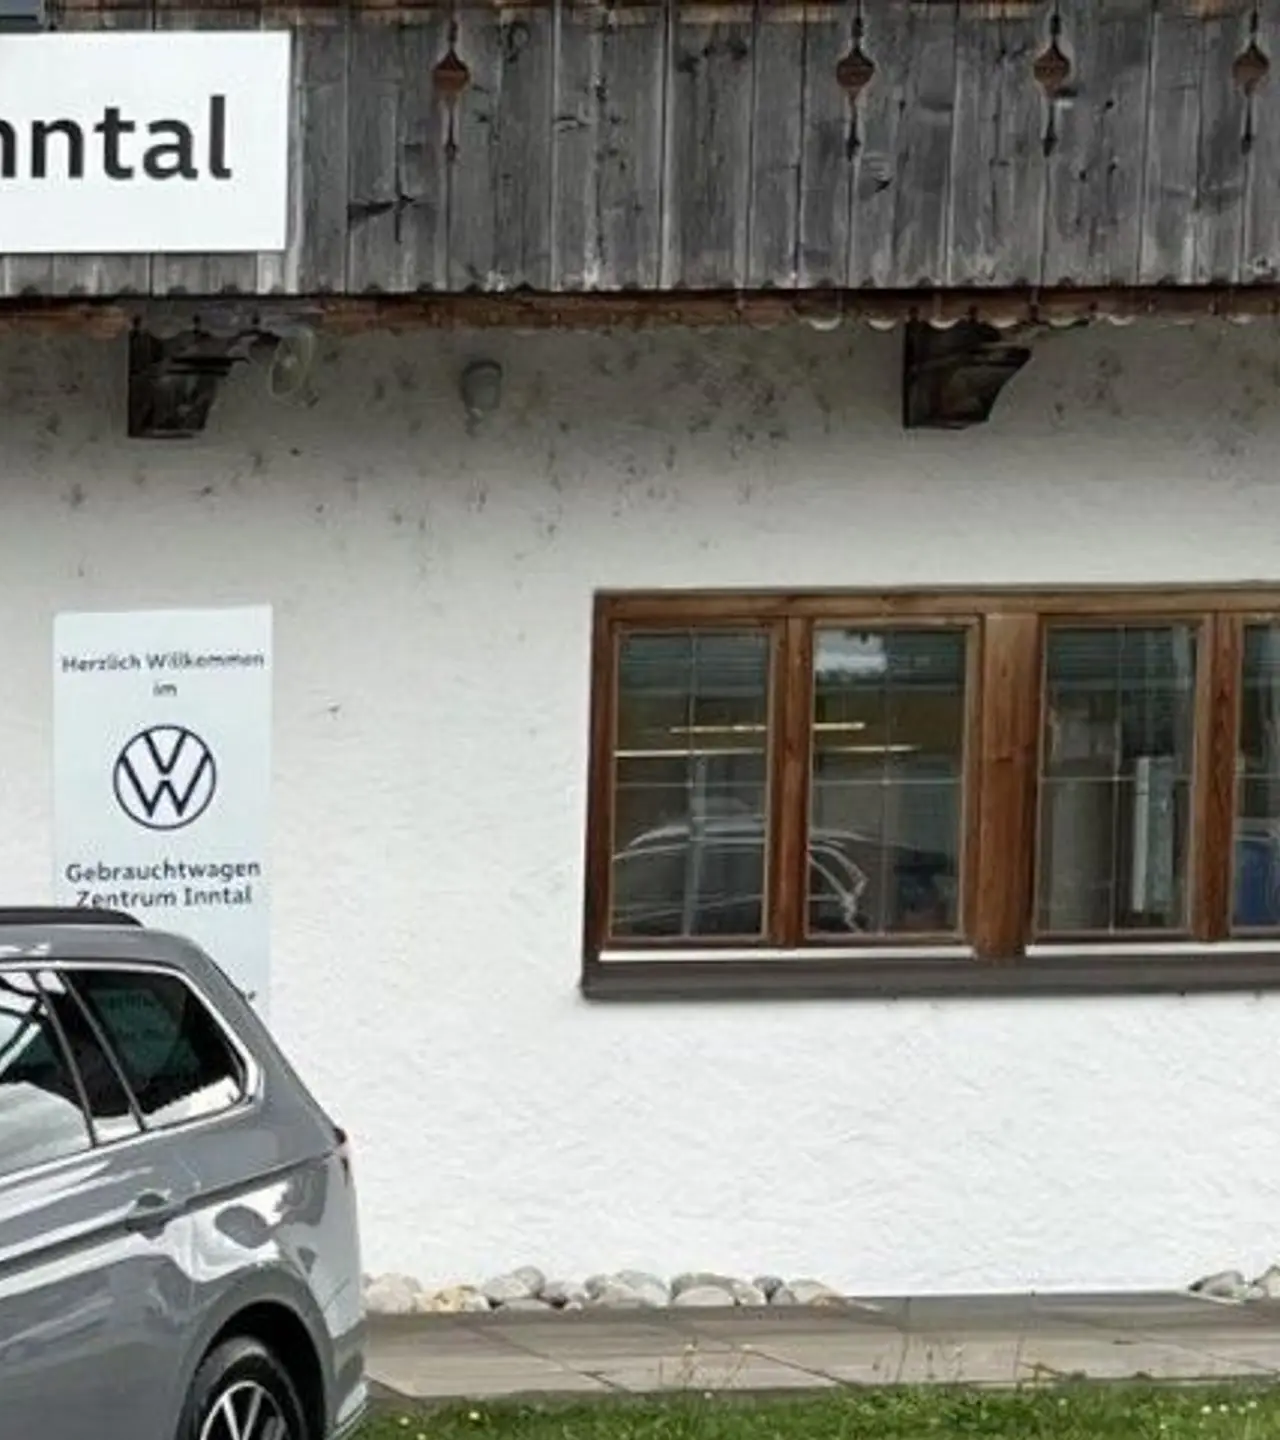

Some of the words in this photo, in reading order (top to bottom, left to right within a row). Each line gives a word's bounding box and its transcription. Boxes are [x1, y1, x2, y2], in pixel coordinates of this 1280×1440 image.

[62, 654, 141, 672] Herzlich
[146, 652, 264, 670] Willkommen
[153, 681, 177, 697] im
[65, 858, 261, 883] Gebrauchtwagen
[76, 889, 177, 908] Zentrum
[184, 886, 251, 905] Inntal
